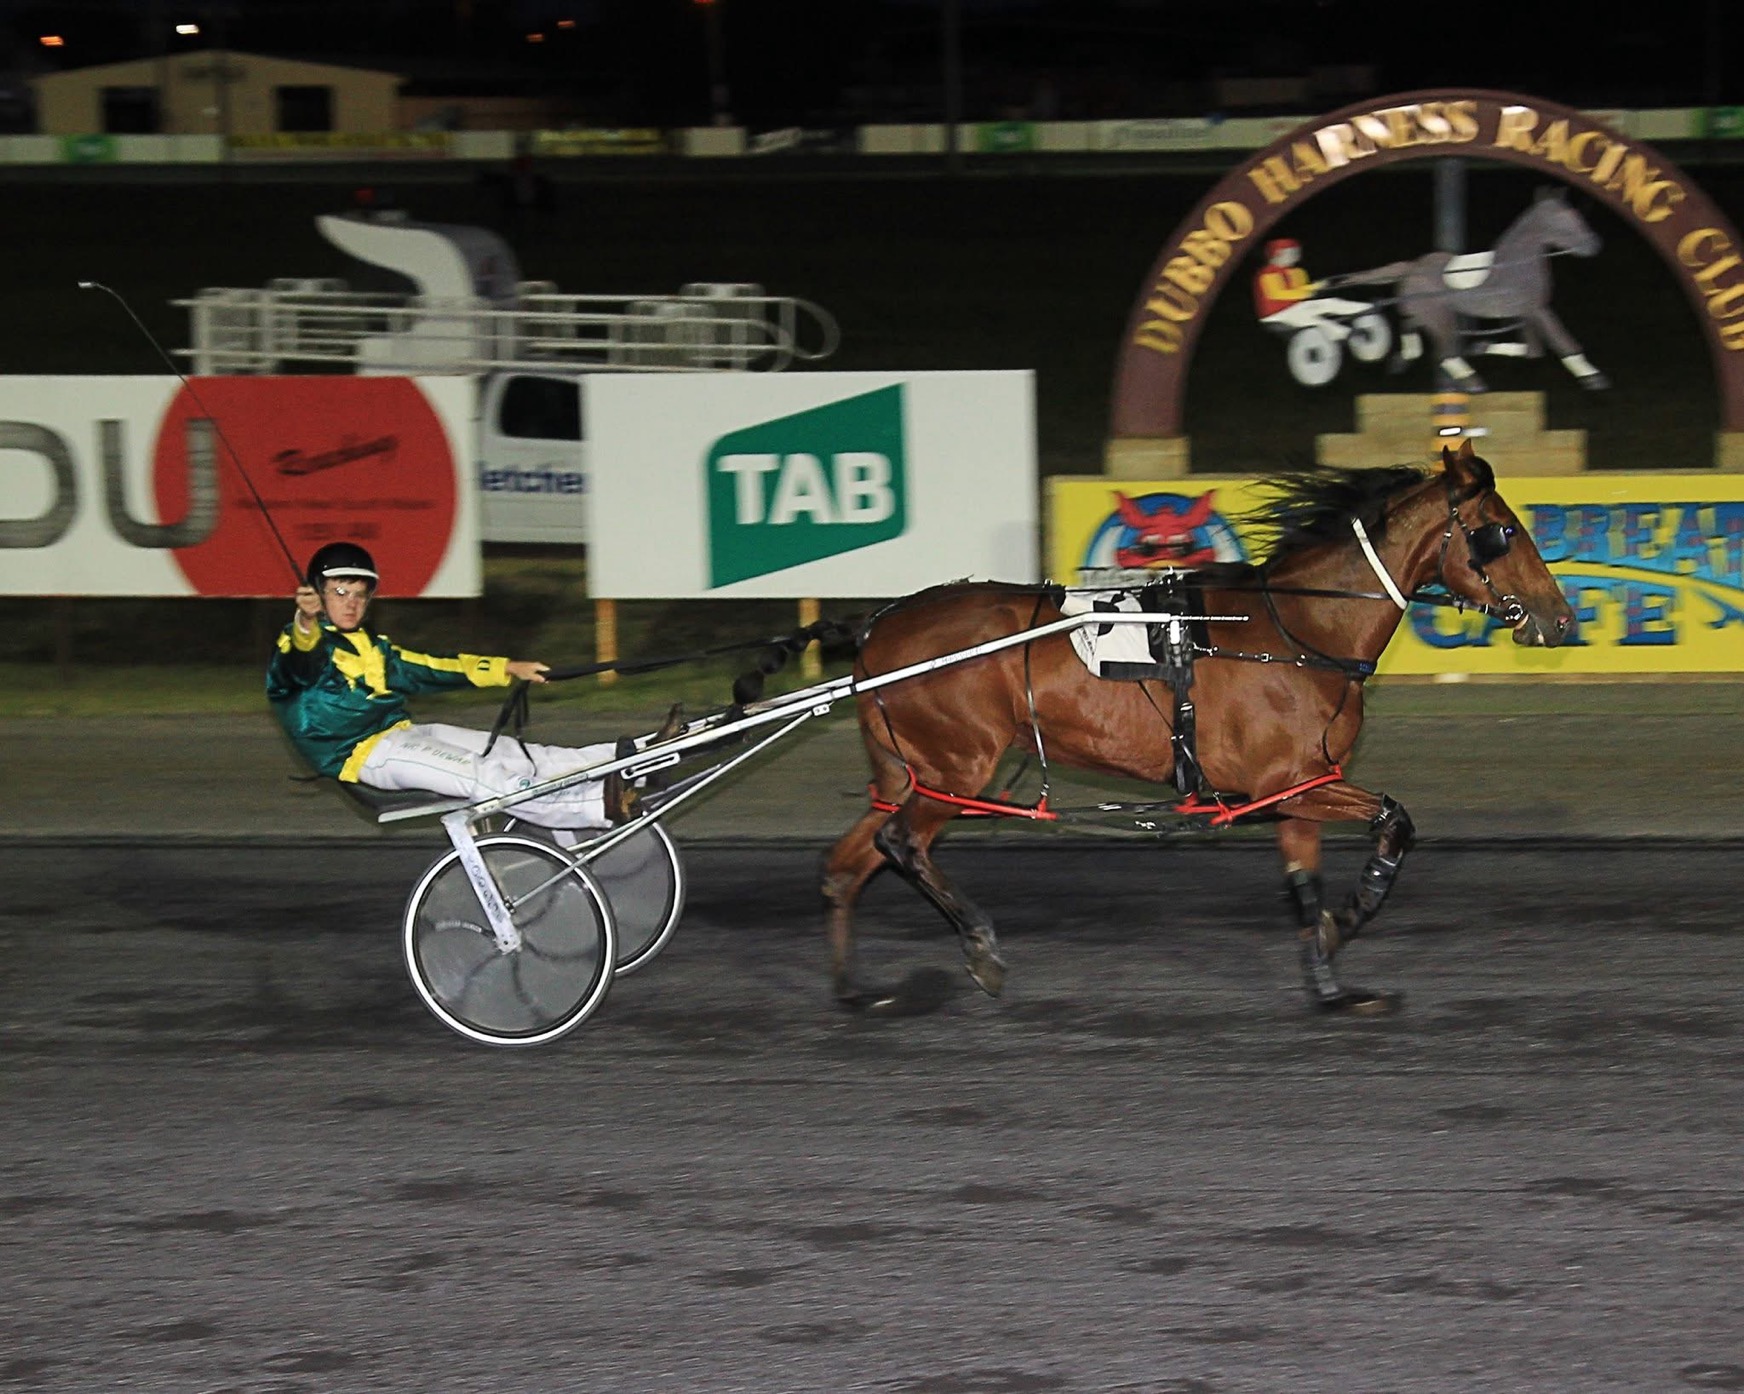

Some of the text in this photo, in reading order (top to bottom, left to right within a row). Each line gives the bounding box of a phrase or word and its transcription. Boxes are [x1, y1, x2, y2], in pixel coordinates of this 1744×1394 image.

[1134, 202, 1253, 353] DUBBO
[1248, 101, 1478, 203] HARNESS
[1495, 106, 1686, 222] RACING
[717, 452, 895, 525] TAB
